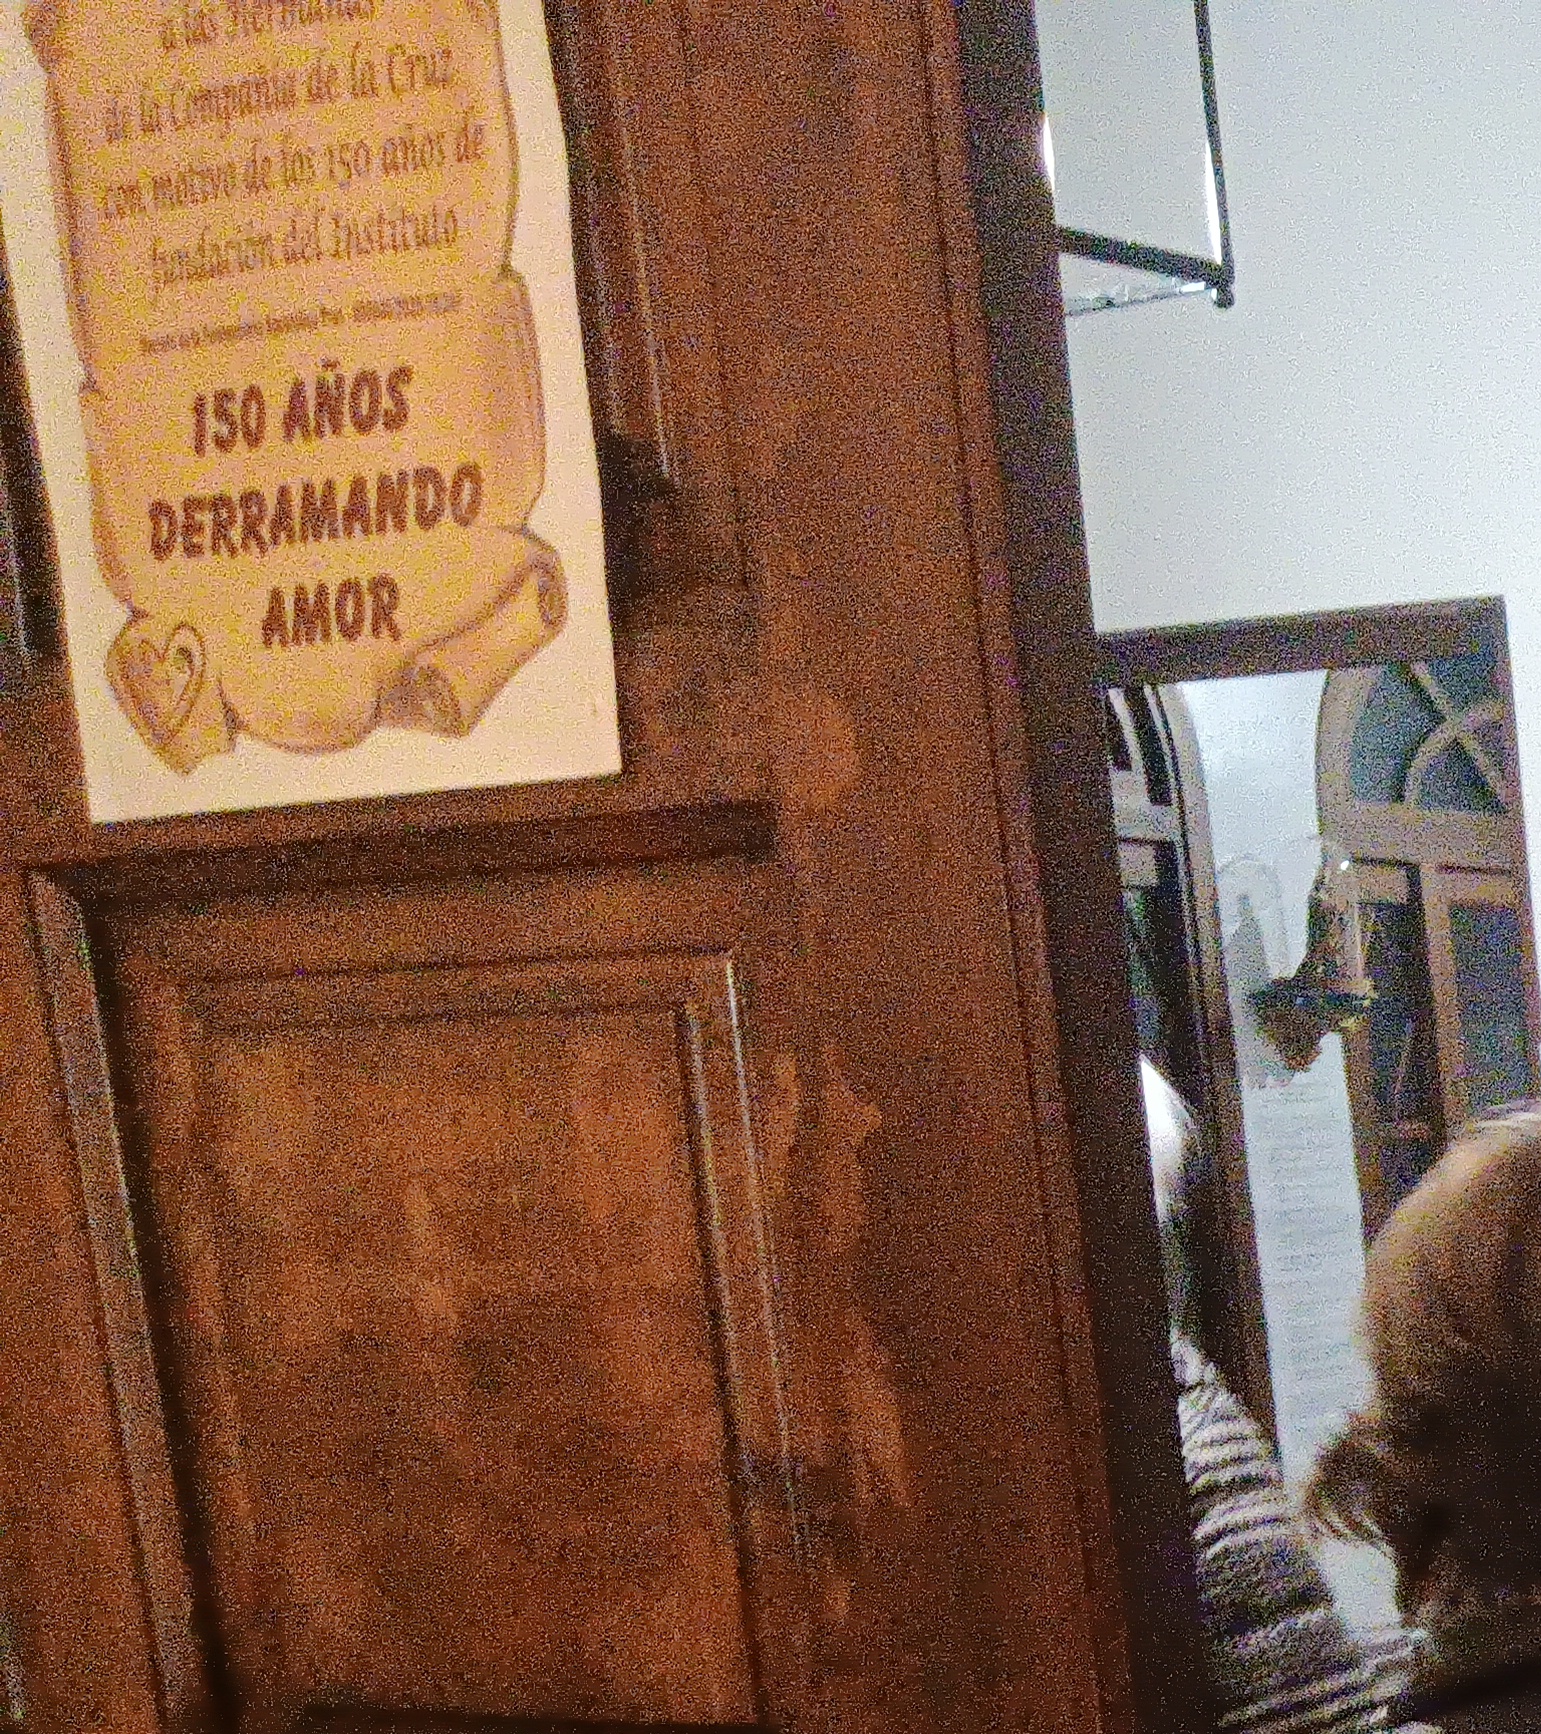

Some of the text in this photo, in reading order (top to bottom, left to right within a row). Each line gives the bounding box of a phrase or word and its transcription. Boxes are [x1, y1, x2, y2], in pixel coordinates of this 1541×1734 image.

[306, 51, 340, 103] de
[349, 41, 380, 100] la
[387, 42, 453, 97] Cruz
[242, 138, 273, 193] de
[280, 132, 316, 189] los
[327, 138, 371, 191] 150
[381, 122, 447, 176] años
[455, 105, 485, 164] de
[283, 208, 325, 264] del
[331, 203, 461, 260] Instituto
[192, 361, 415, 457] 150 AÑOS
[147, 463, 483, 561] DERRAMANDO
[261, 574, 401, 650] AMOR
